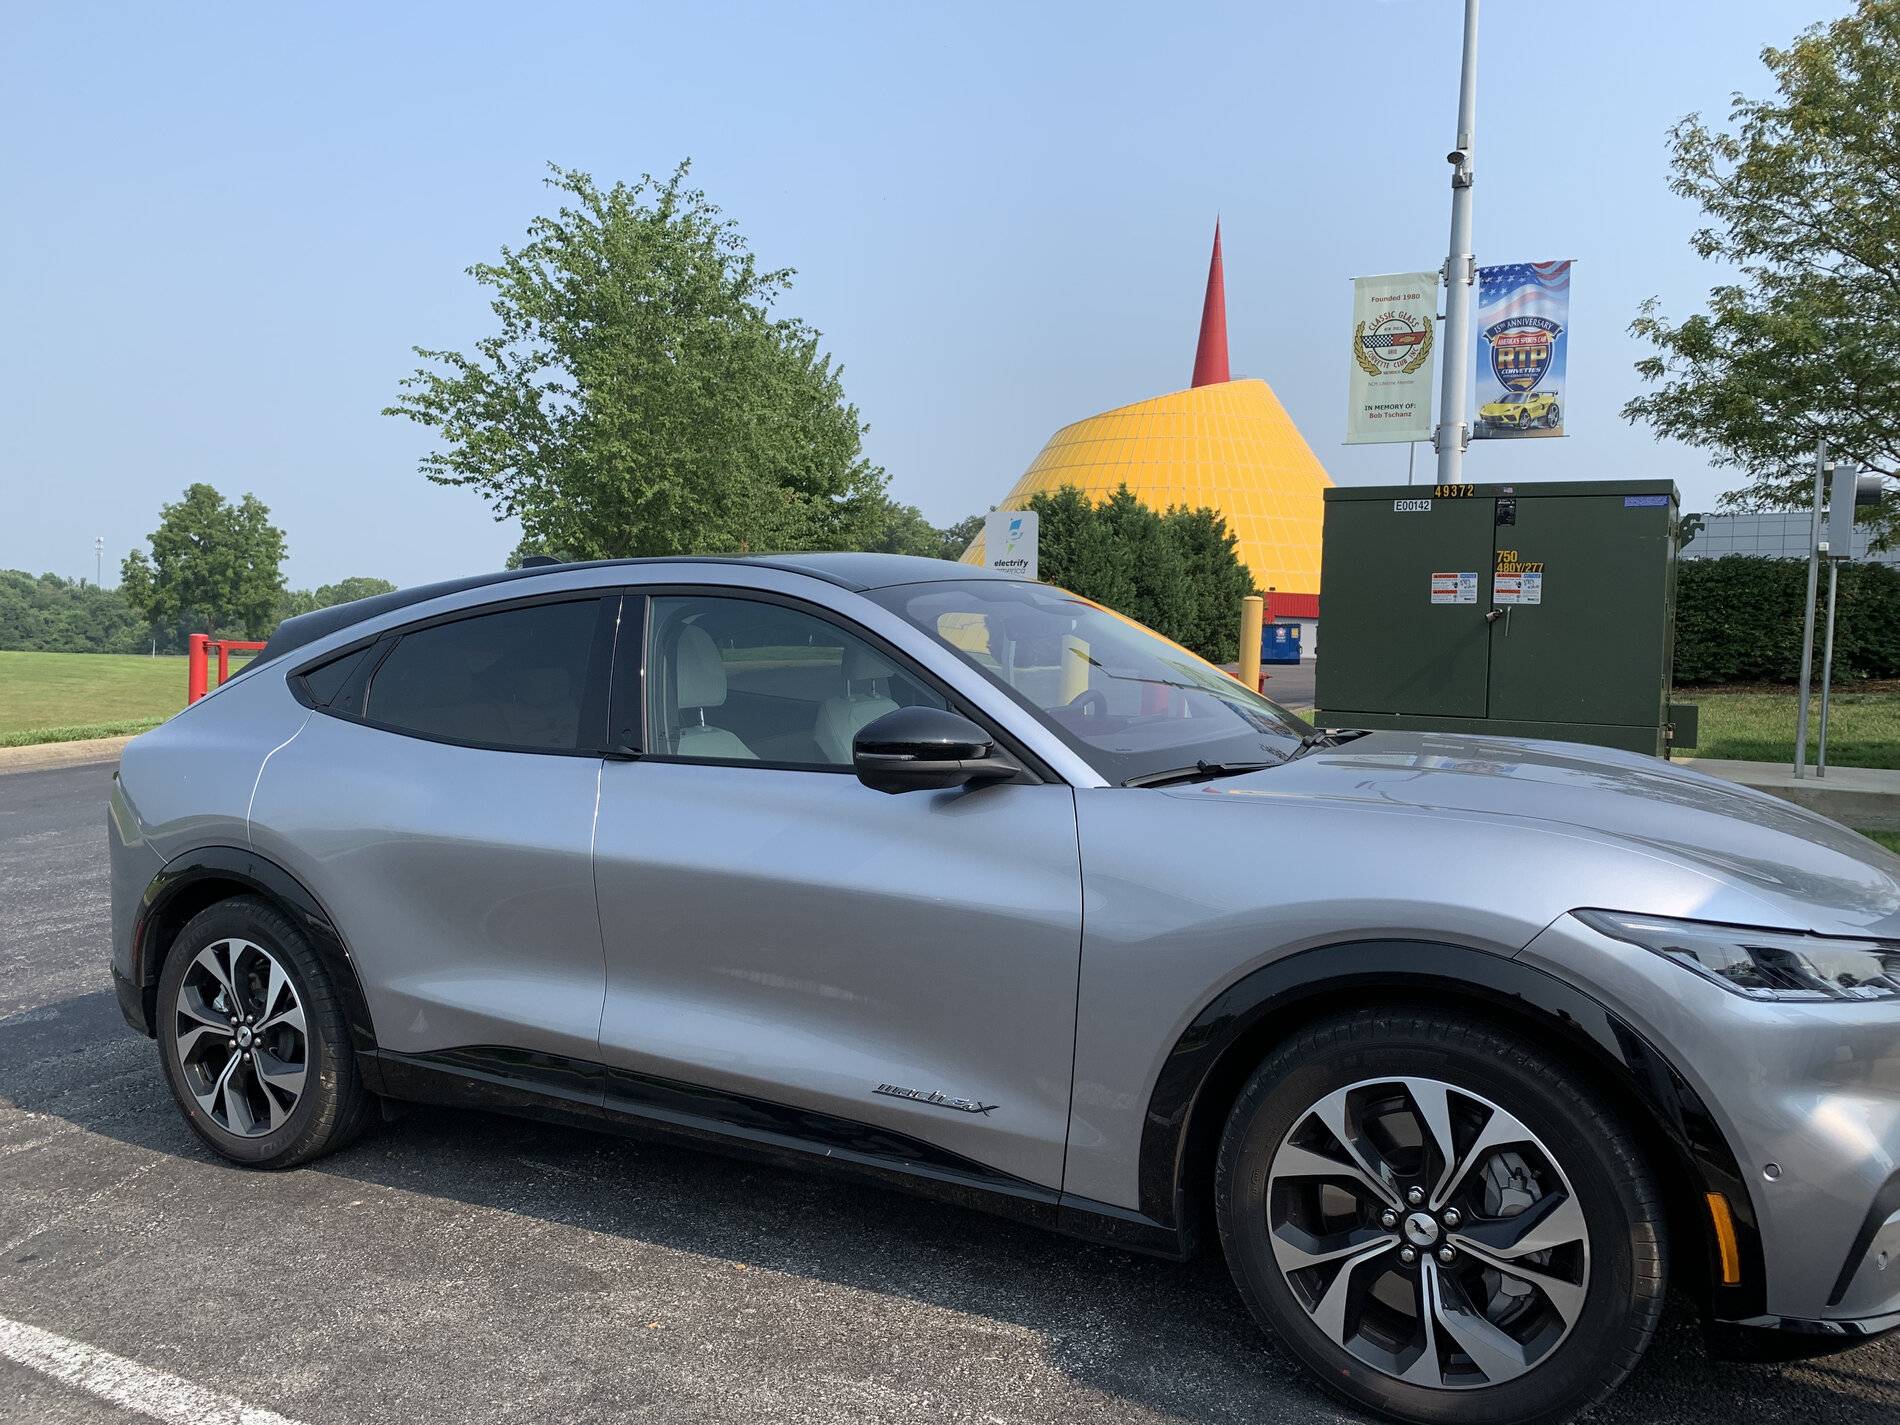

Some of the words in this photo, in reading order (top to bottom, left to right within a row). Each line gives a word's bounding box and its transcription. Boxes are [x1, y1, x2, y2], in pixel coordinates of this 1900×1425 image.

[1372, 294, 1401, 303] Founded
[1403, 293, 1421, 301] 1980
[1368, 310, 1396, 331] CLASSIC
[1398, 311, 1420, 328] GLASS
[1507, 318, 1554, 330] ANNIVERSARY
[1367, 350, 1390, 369] CORVETTE
[1393, 359, 1408, 369] CLUB
[1409, 347, 1419, 359] INC
[1498, 346, 1547, 368] RTP
[1375, 402, 1404, 411] MEMORY
[1405, 402, 1416, 410] OF:
[1369, 411, 1382, 419] Bob
[1384, 410, 1412, 419] Tschanz
[1435, 484, 1474, 497] 49372
[1395, 500, 1430, 512] E00142
[1496, 550, 1518, 563] 750
[994, 559, 1028, 568] electrify
[1496, 562, 1544, 573] 480Y/277
